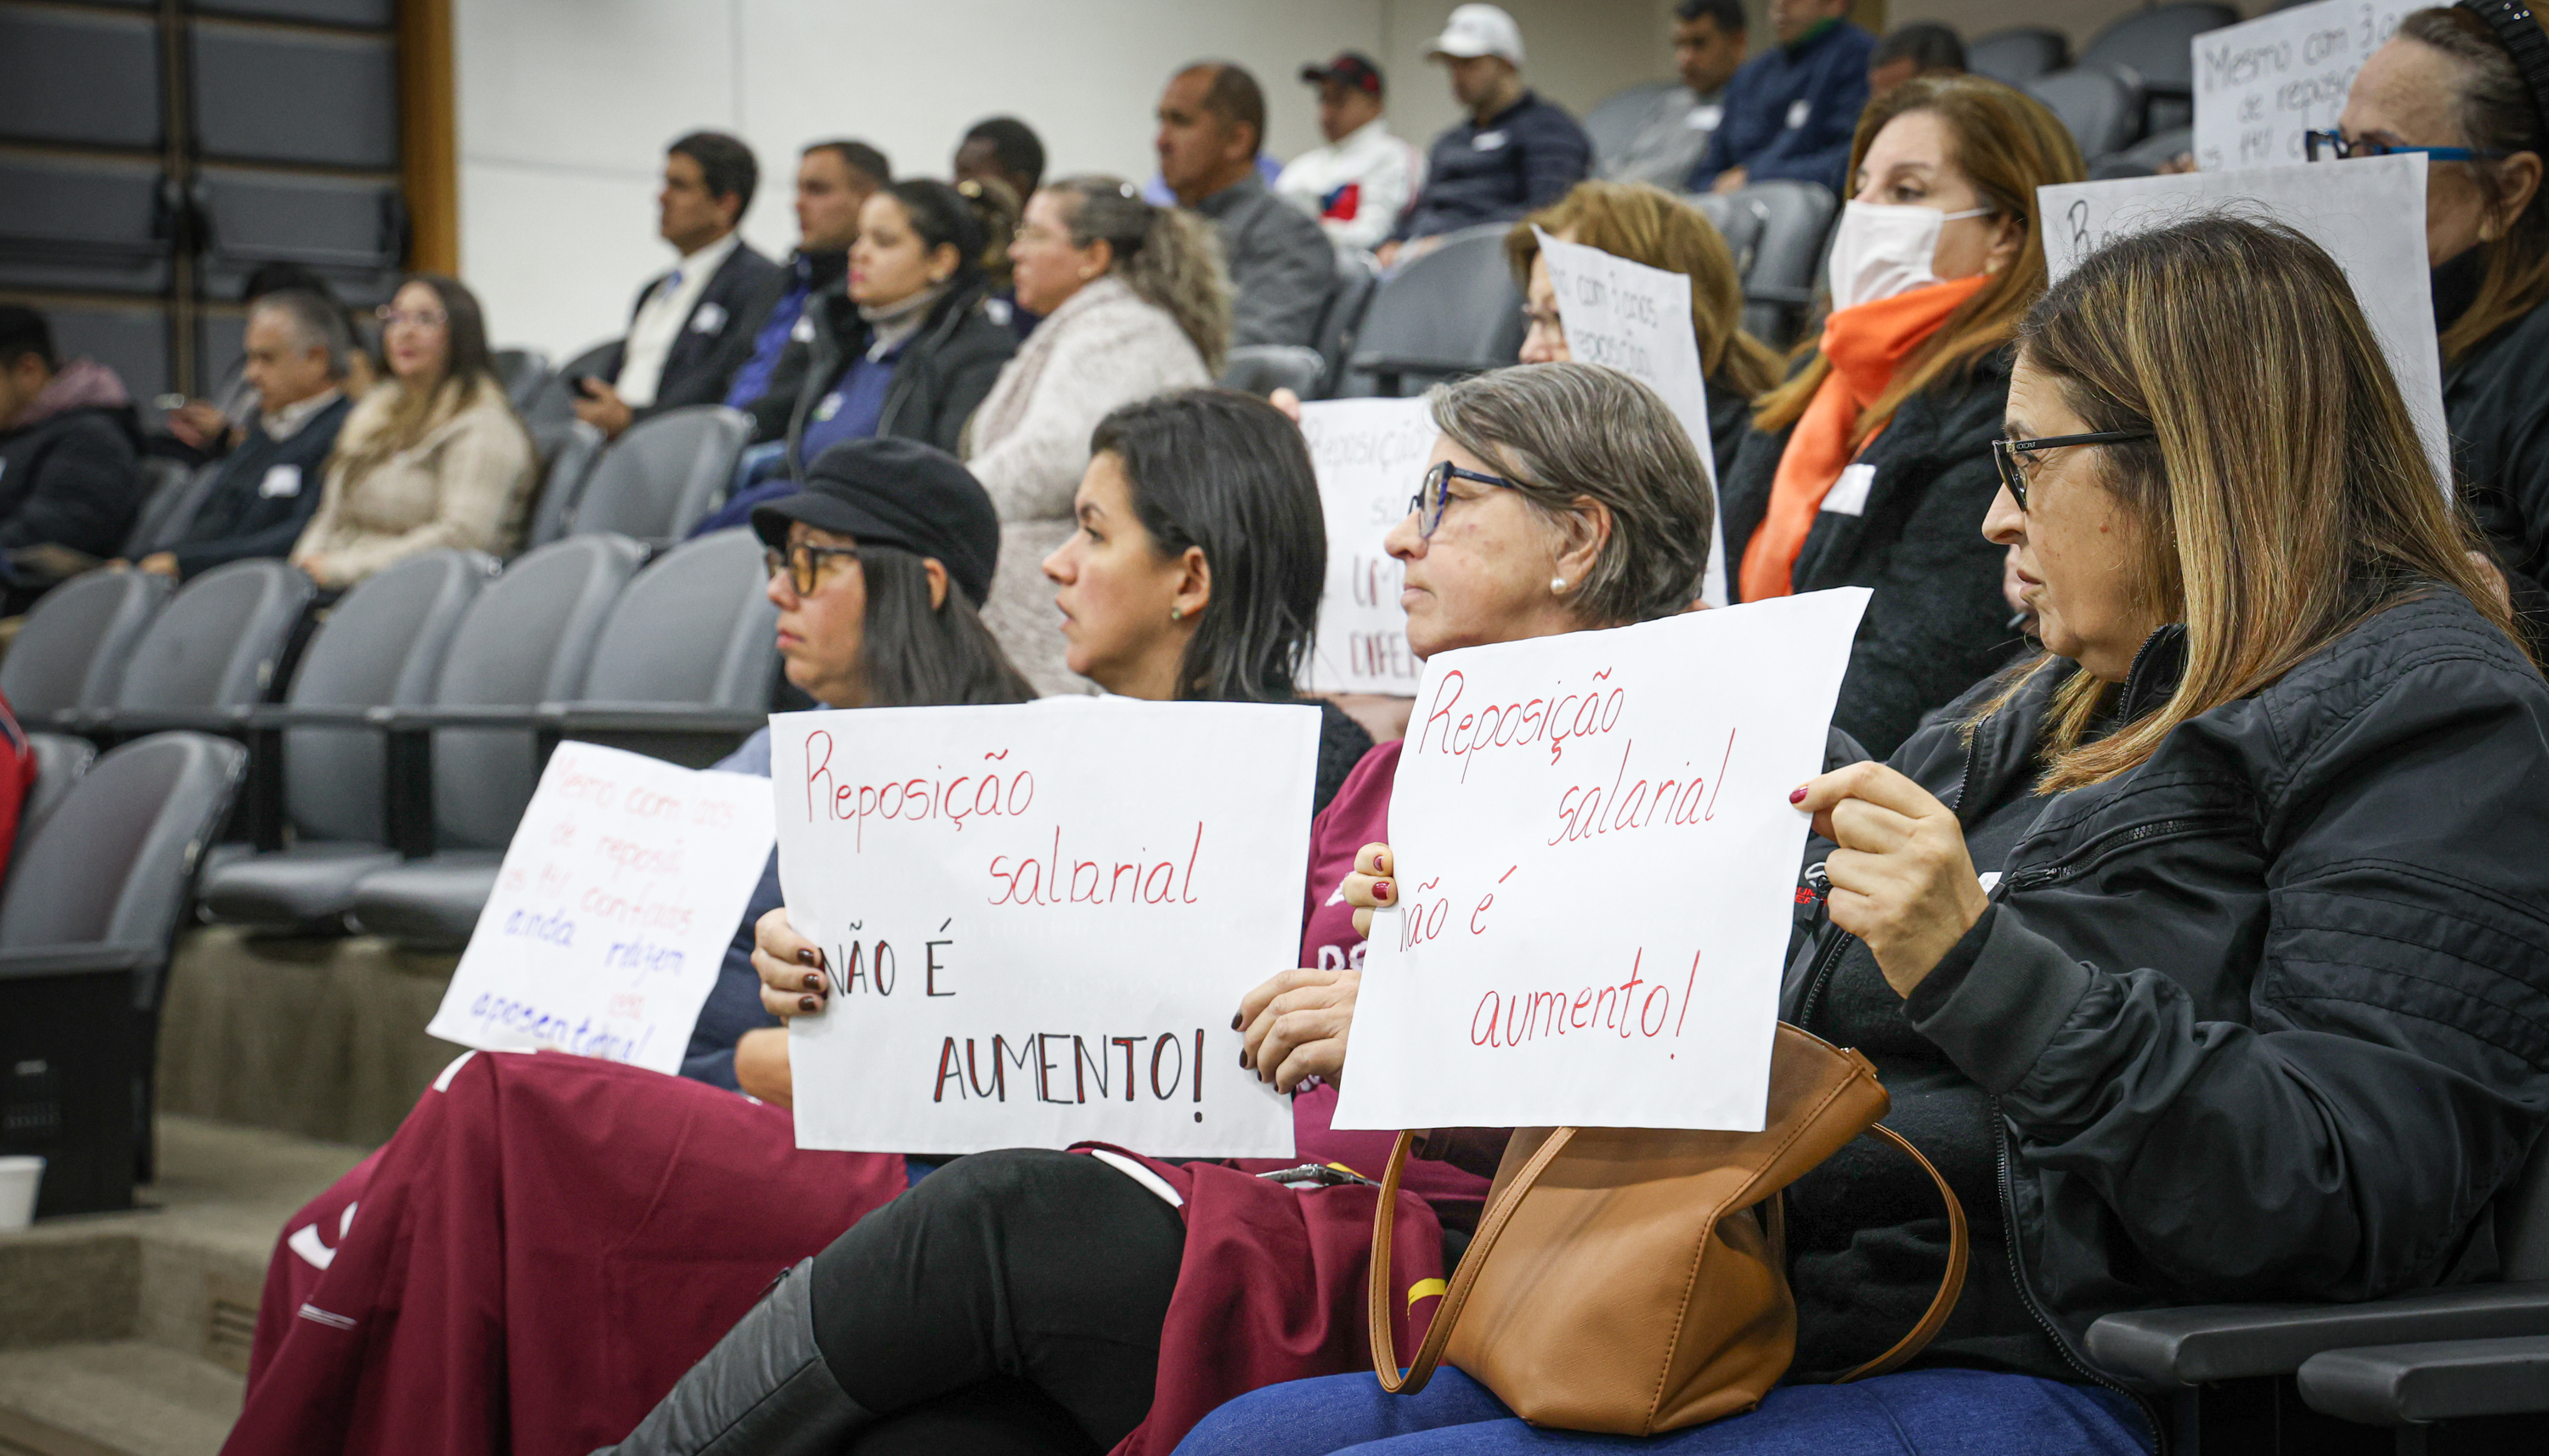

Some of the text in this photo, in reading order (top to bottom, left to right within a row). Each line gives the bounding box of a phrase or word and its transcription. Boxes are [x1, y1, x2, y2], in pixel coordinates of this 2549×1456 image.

[1419, 667, 1625, 784] Reposição
[805, 730, 1034, 854] Reposição
[1547, 727, 1736, 846] salarial
[988, 821, 1203, 906] salarial
[1400, 865, 1518, 952] não é
[818, 917, 957, 998] NÃO É
[1471, 946, 1701, 1061] aumento!
[933, 1028, 1205, 1124] AUMENTO!
